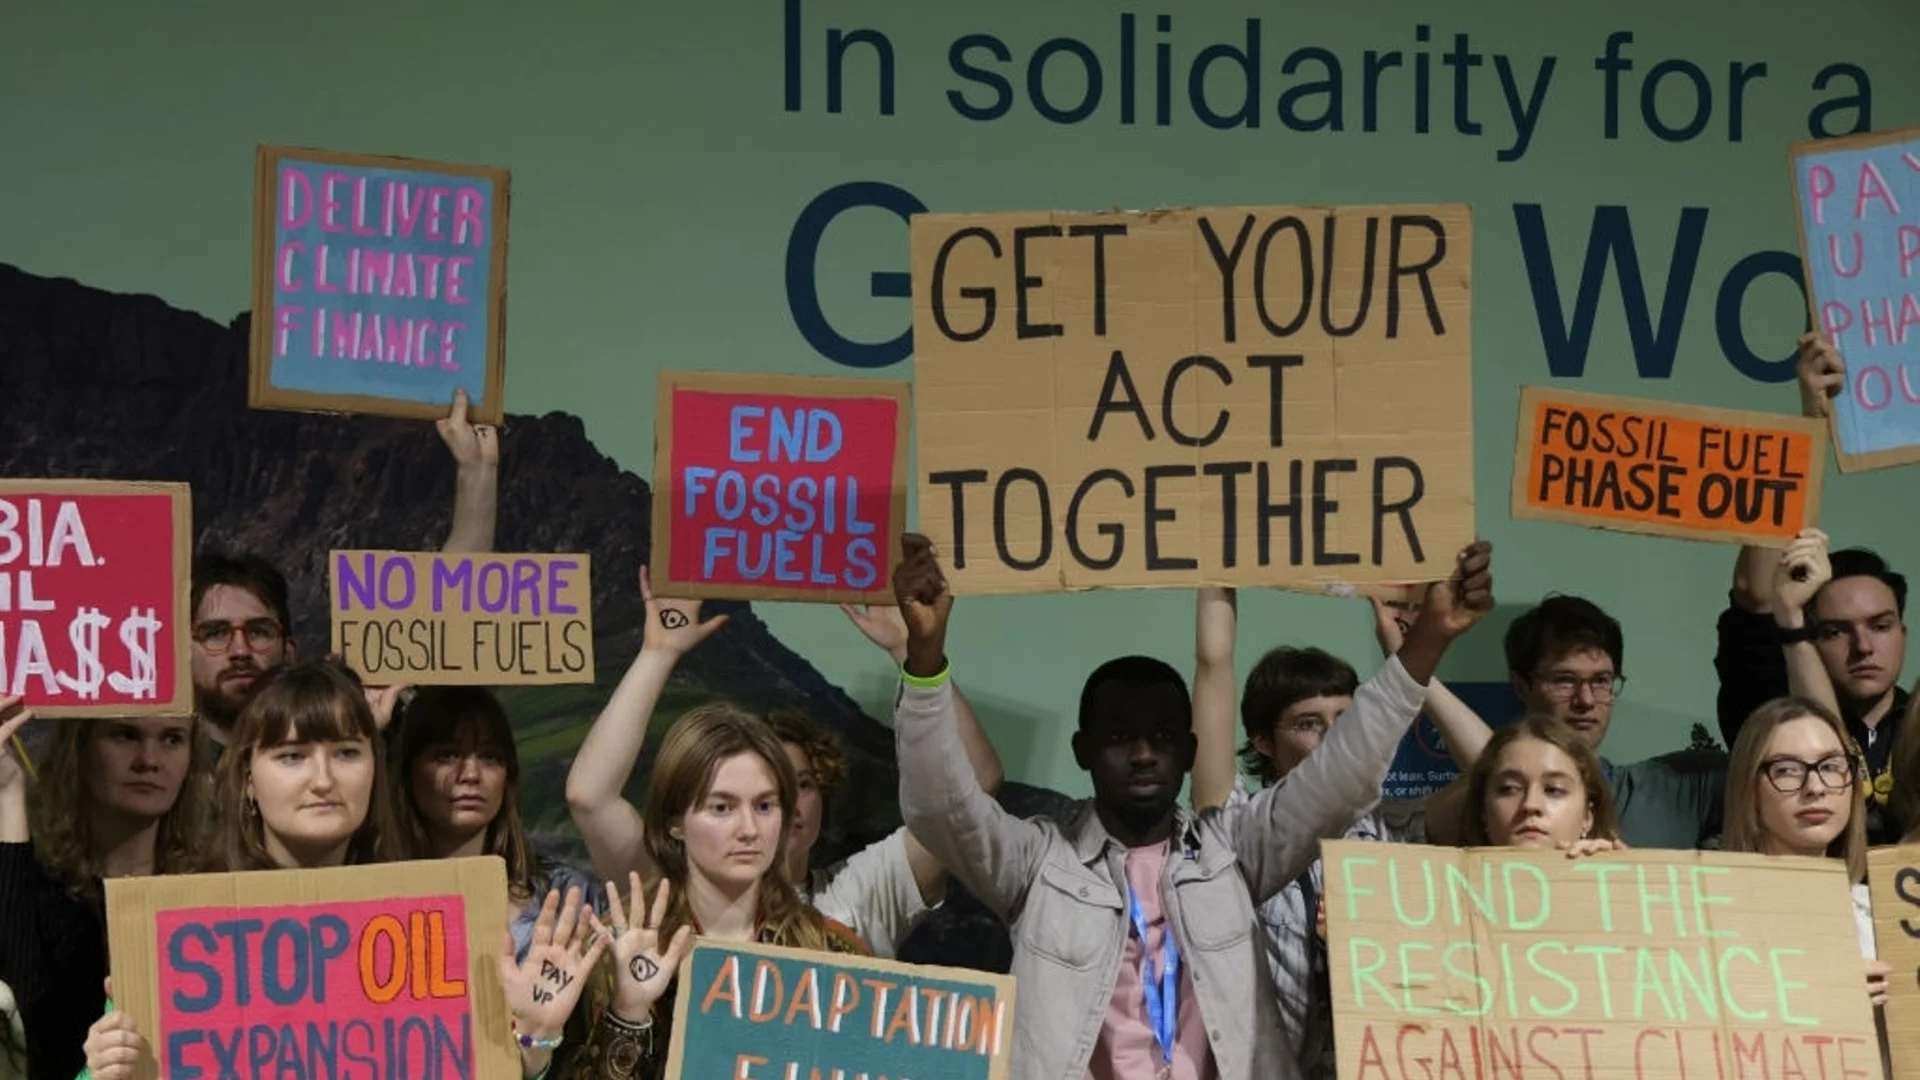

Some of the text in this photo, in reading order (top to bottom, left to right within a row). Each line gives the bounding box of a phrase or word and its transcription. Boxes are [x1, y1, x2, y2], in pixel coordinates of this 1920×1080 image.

[784, 0, 1872, 162] In solidarity for a
[281, 168, 484, 248] DELIVER
[1808, 151, 1920, 225] PA
[277, 241, 474, 305] CLIMATE
[931, 214, 1447, 343] GET YOUR
[275, 304, 467, 372] FINANCE
[730, 405, 843, 463] END
[1087, 350, 1304, 447] ACT
[1542, 408, 1804, 478] FOSSIL FUEL
[685, 466, 876, 534] FOSSIL
[929, 456, 1425, 571] TOGETHER
[1539, 455, 1797, 527] PHASE OUT
[337, 553, 579, 617] NO MORE
[703, 527, 877, 588] FUELS
[0, 606, 163, 699] A$$
[341, 618, 587, 675] FOSSIL FUELS
[1342, 857, 1740, 938] FUND THE
[168, 910, 467, 1013] STOP OIL
[533, 984, 553, 1005] UP
[541, 958, 573, 993] PAY
[1349, 937, 1821, 1026] RESISTANCE
[702, 955, 1004, 1055] ADAPTATION
[168, 1012, 471, 1080] EXPANSION
[1357, 1024, 1869, 1080] AGAINST CLIMATE
